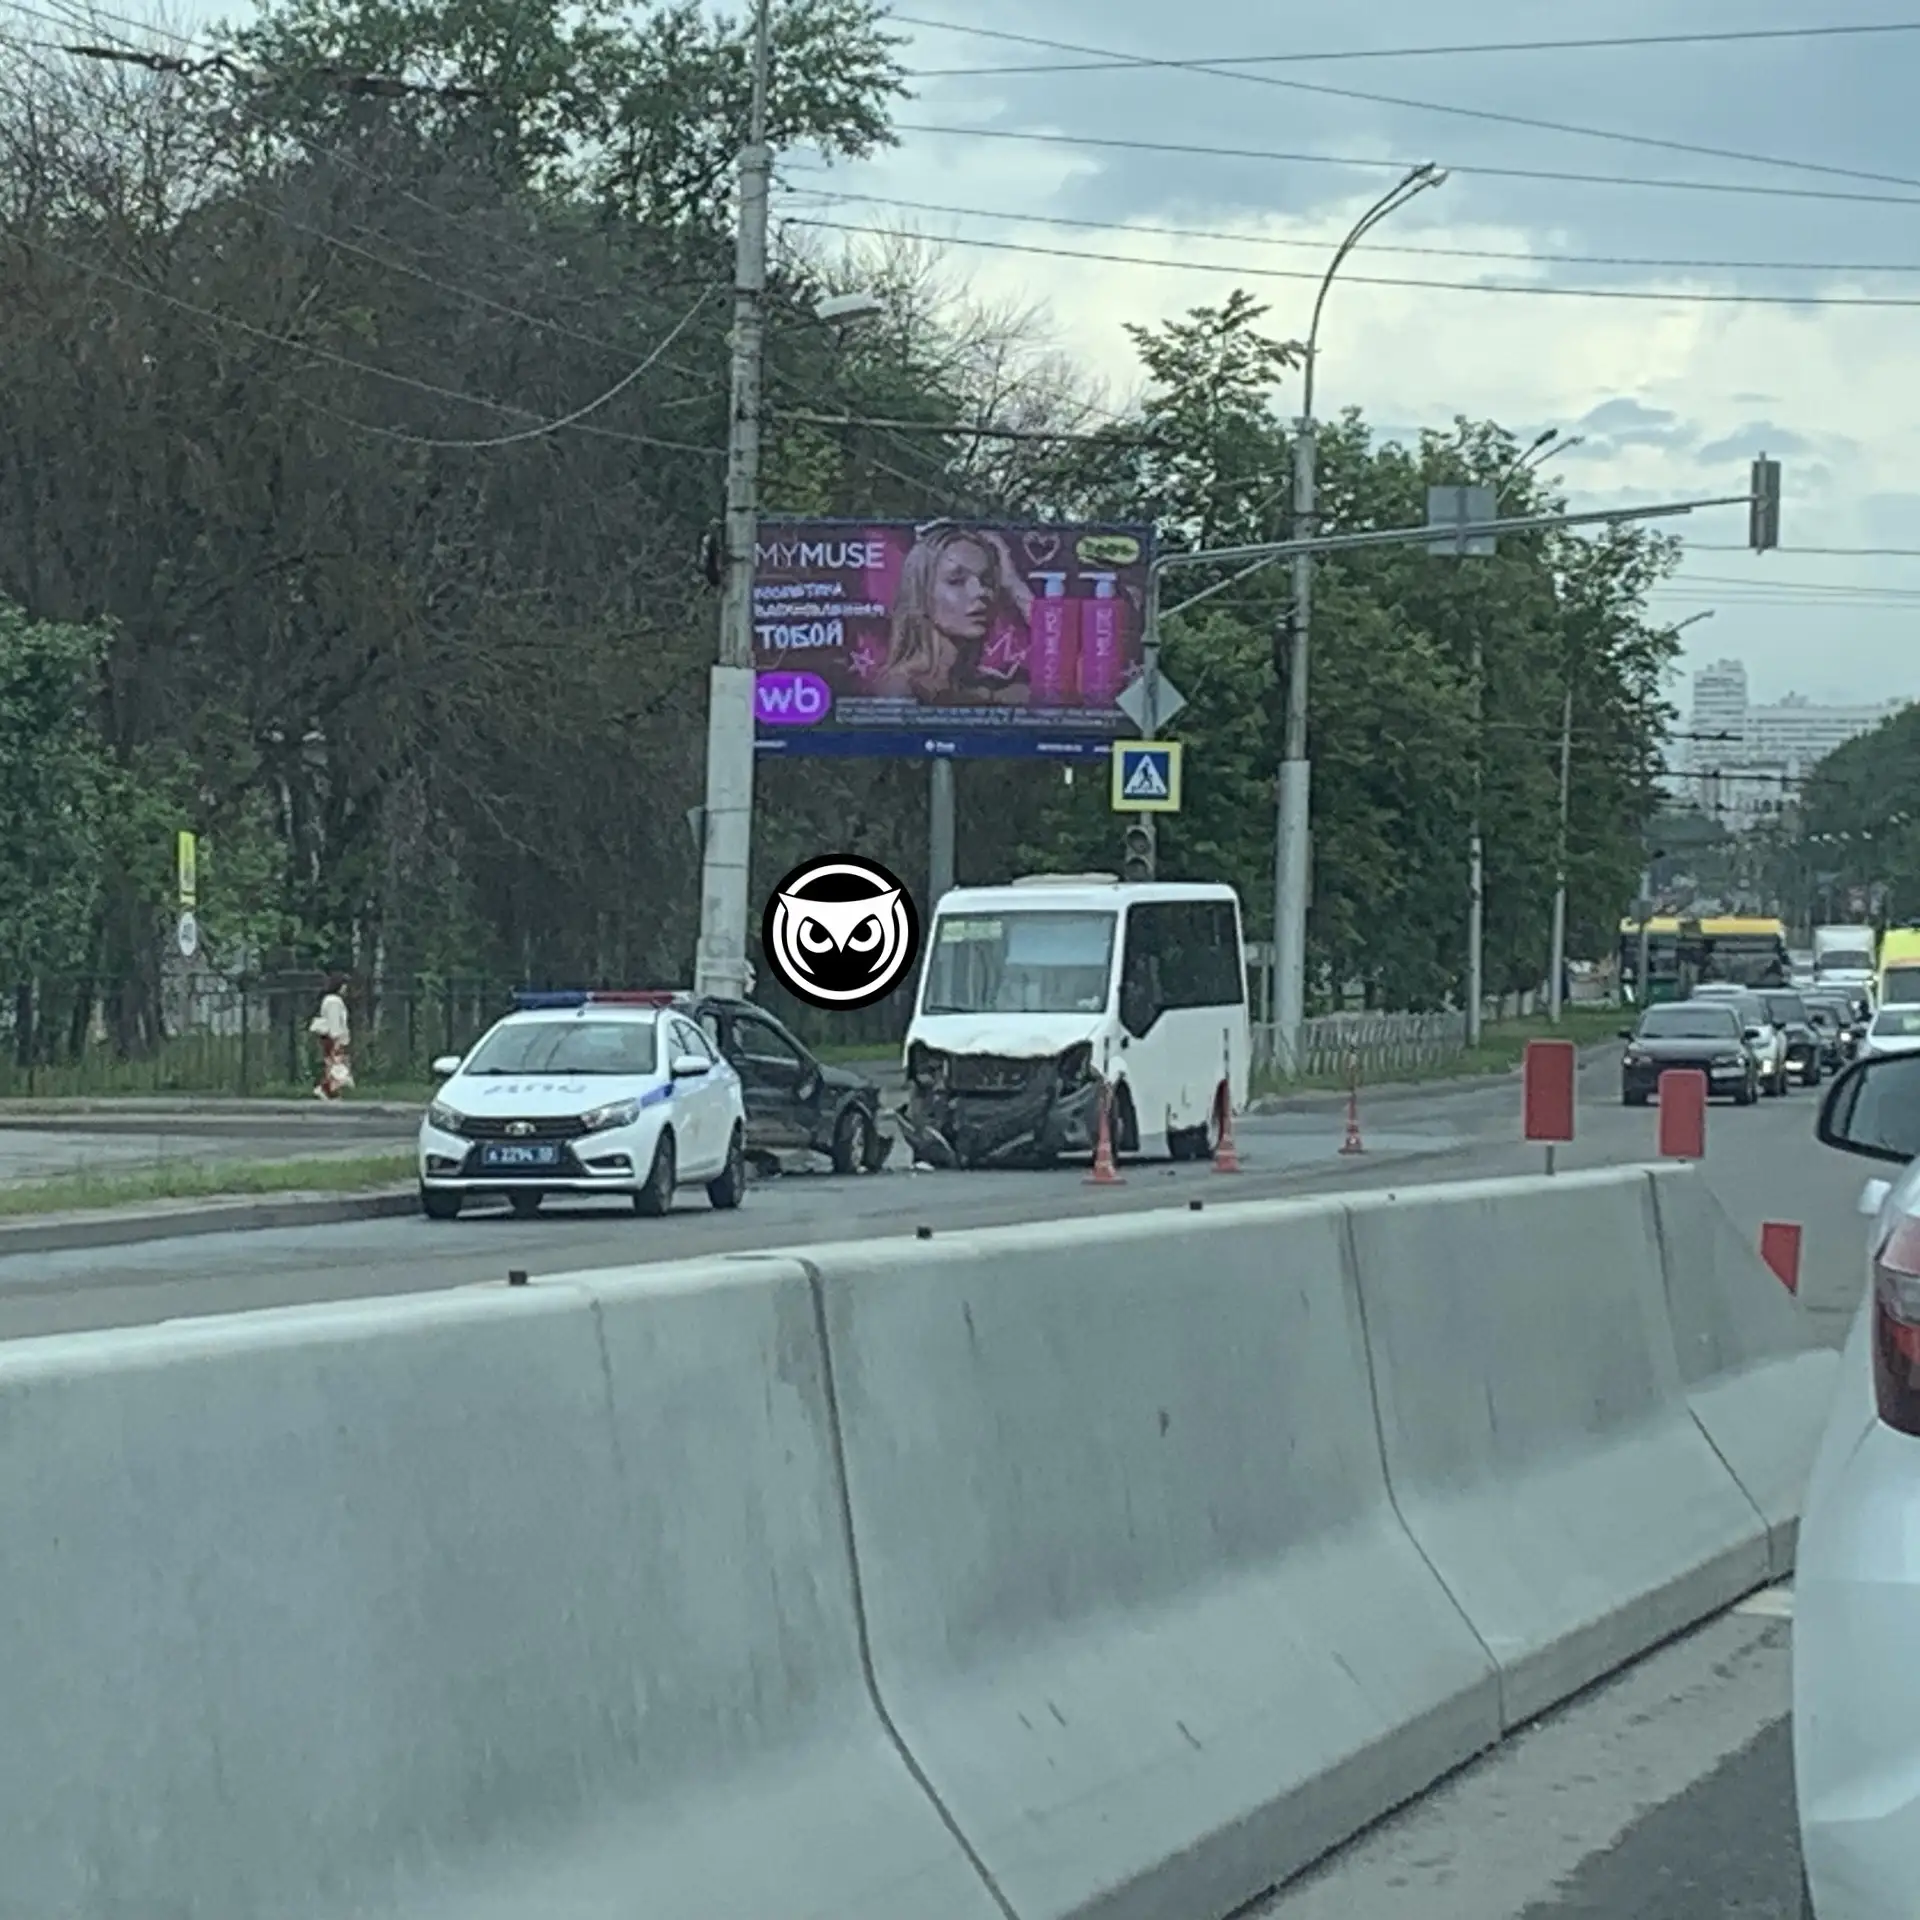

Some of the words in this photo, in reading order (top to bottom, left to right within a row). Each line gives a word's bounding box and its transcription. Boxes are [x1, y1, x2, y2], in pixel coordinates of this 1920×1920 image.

[755, 541, 885, 569] MYMUSE
[755, 619, 844, 650] ТОБОЙ
[758, 676, 821, 713] wb
